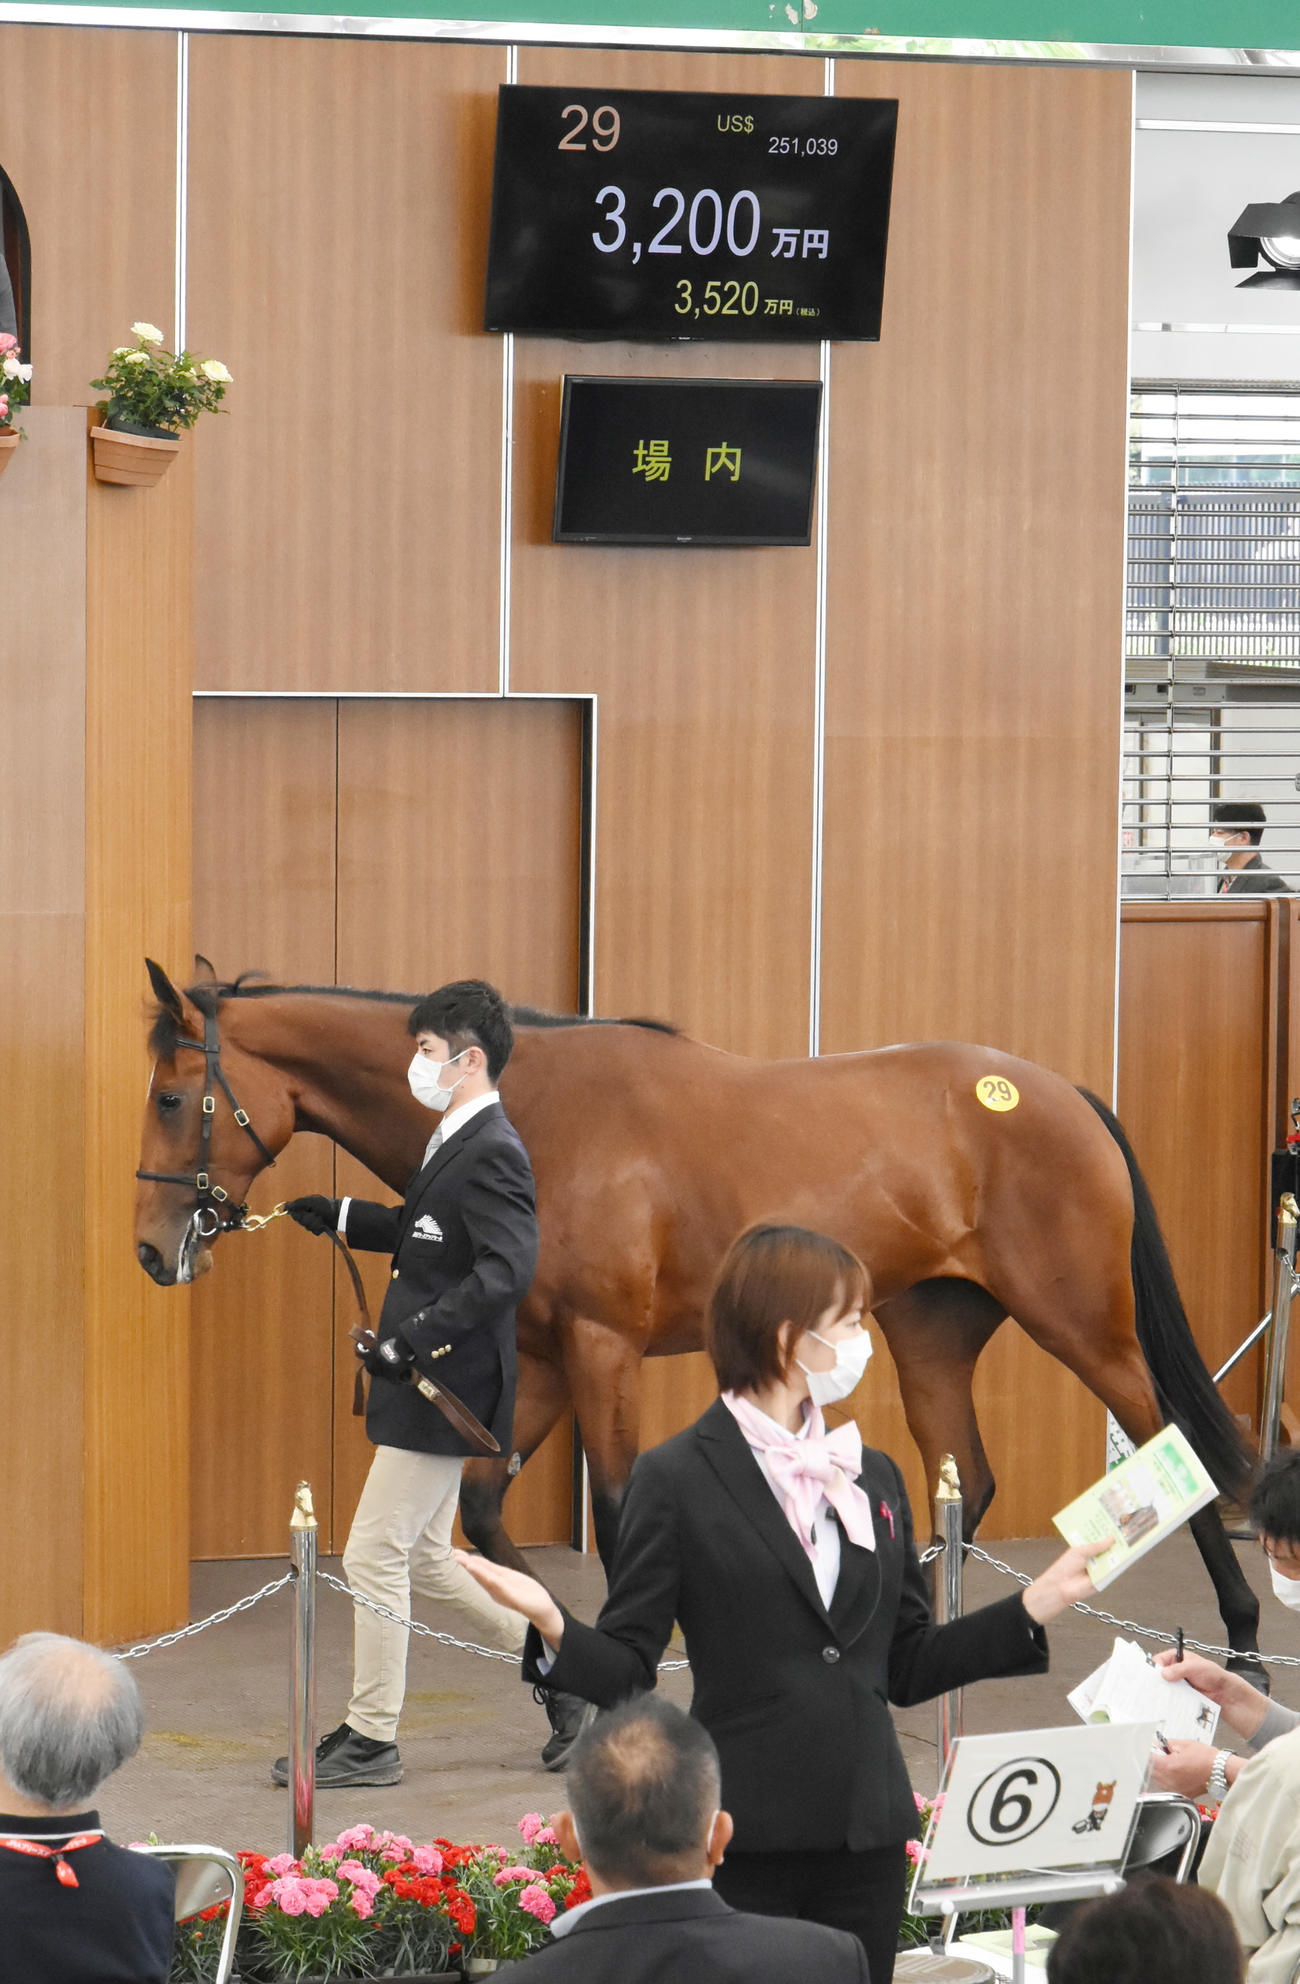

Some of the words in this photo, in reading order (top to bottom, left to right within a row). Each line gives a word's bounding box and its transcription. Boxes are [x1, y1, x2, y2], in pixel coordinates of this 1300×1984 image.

[558, 104, 621, 152] 29
[717, 114, 755, 134] US$
[767, 136, 839, 157] 251,039
[591, 185, 761, 265] 3,200
[770, 228, 830, 259] 万円
[674, 279, 759, 320] 3,520
[763, 298, 794, 316] 万円
[982, 1080, 1012, 1102] 29
